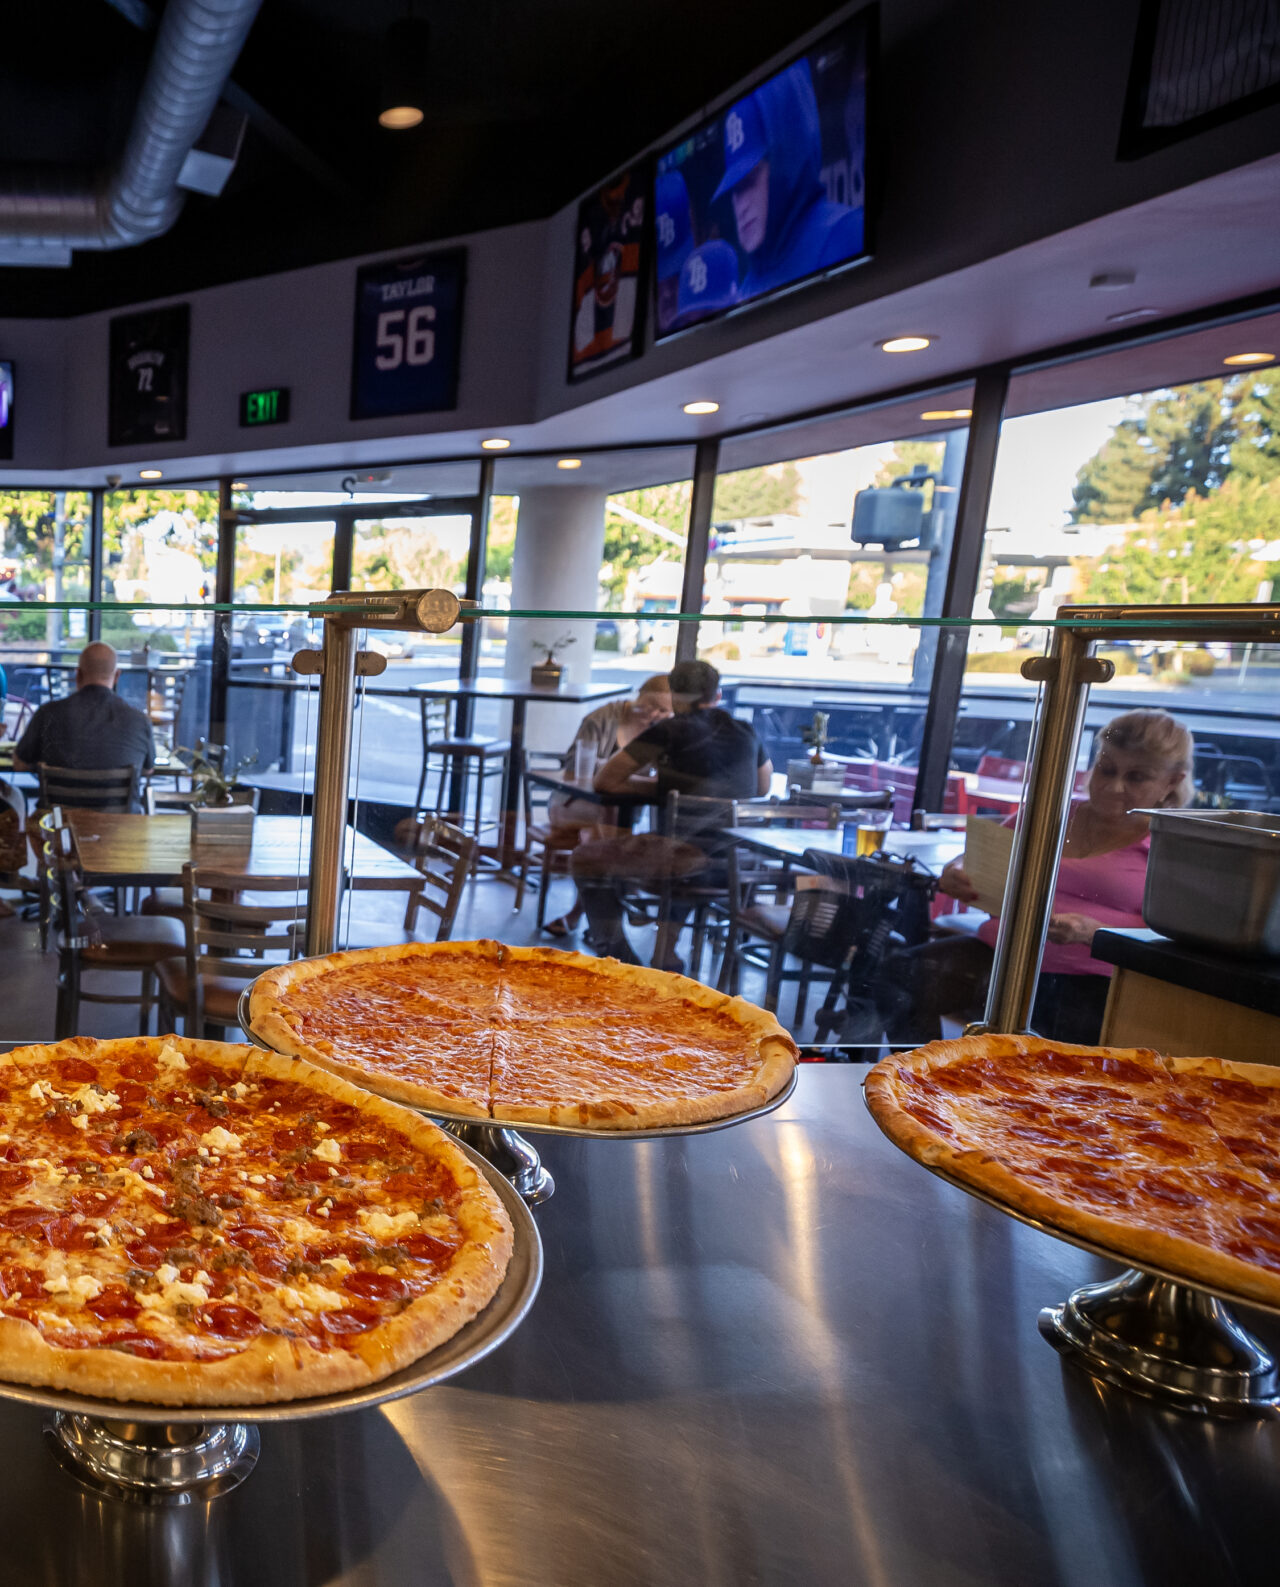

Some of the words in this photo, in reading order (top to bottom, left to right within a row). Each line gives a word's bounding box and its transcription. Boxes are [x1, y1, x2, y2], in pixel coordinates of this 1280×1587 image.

[381, 275, 436, 302] TAYLOR
[375, 305, 437, 371] 56
[247, 390, 280, 424] EXIT
